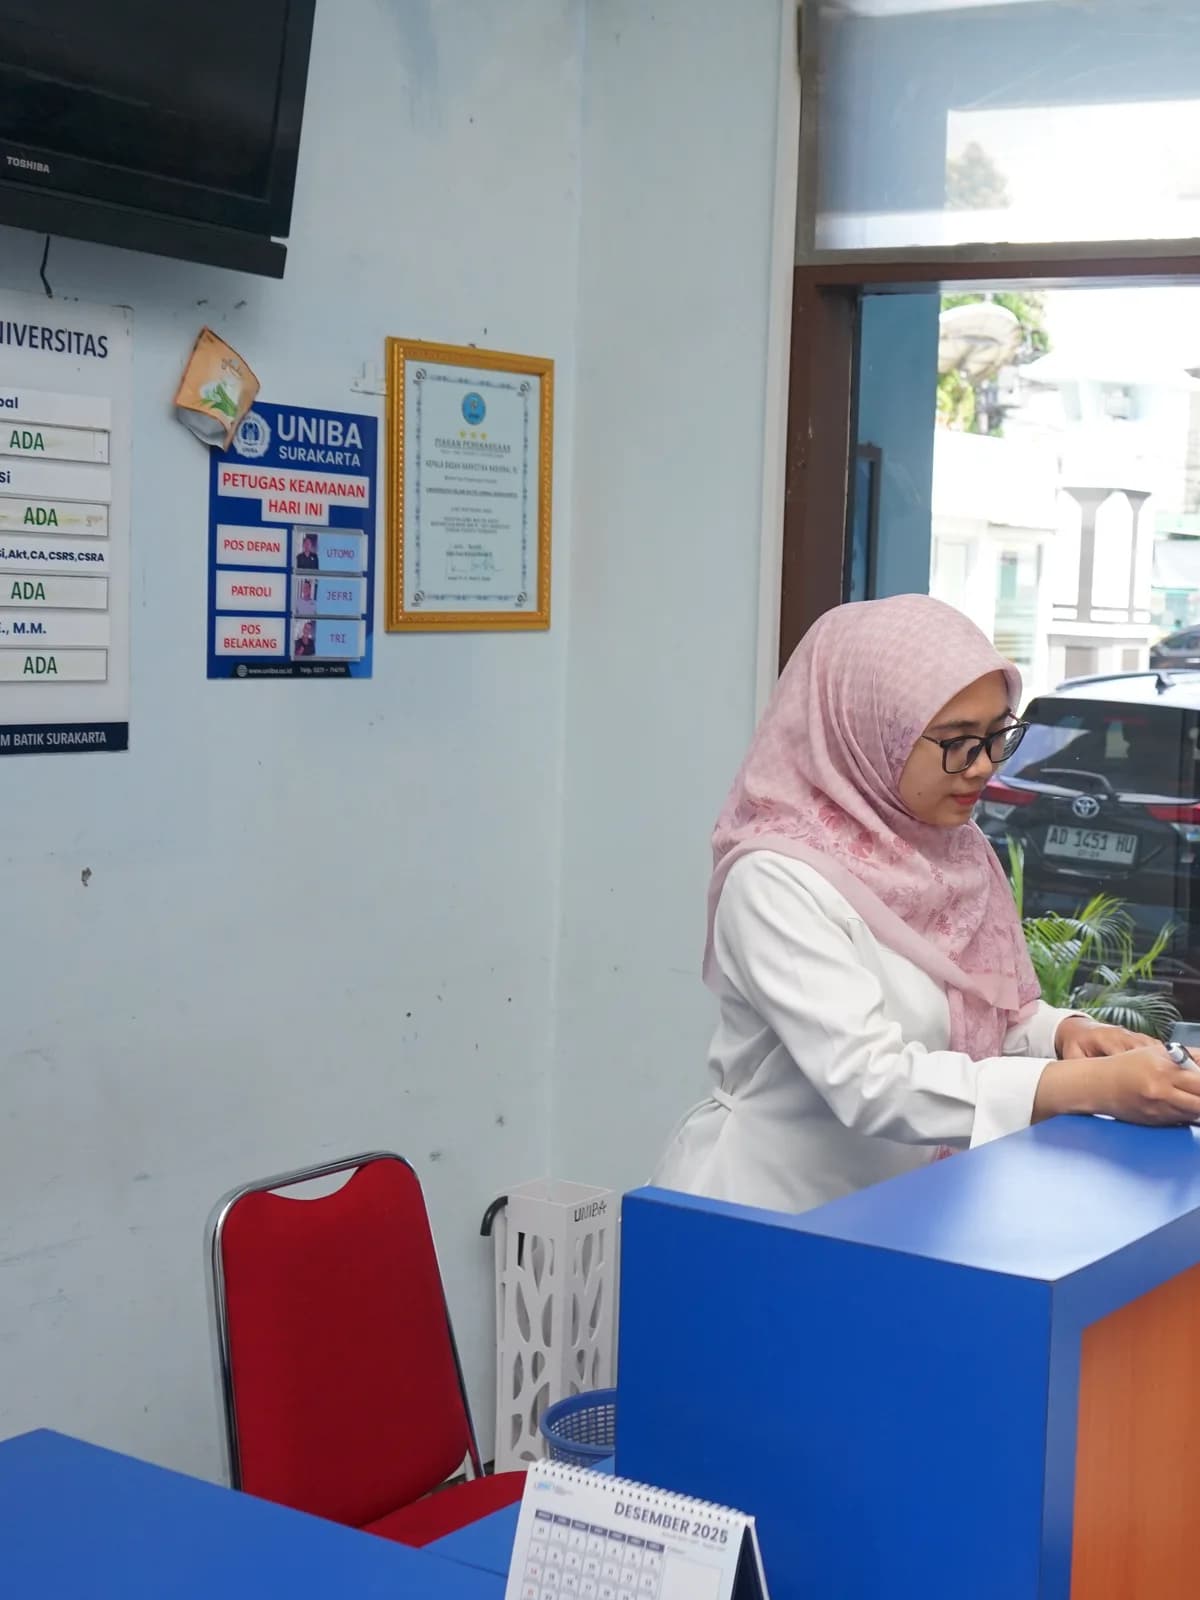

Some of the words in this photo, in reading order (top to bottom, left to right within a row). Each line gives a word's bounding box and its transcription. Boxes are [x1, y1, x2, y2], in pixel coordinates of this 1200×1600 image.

[6, 155, 50, 174] TOSHIBA
[9, 430, 45, 451] ADA
[277, 413, 363, 449] UNIBA
[279, 446, 361, 467] SURAKARTA
[222, 472, 286, 492] PETUGAS
[289, 479, 366, 498] KEAMANAN
[23, 507, 58, 527] ADA
[268, 500, 301, 514] HARI
[304, 503, 323, 516] INI
[223, 539, 244, 551] POS
[247, 541, 280, 553] DEPAN
[10, 581, 46, 600] ADA
[231, 585, 272, 597] PATROLI
[13, 622, 47, 634] M.M.
[240, 624, 261, 634] POS
[223, 637, 277, 649] BELAKANG
[329, 633, 346, 644] TRI
[23, 656, 58, 675] ADA
[14, 733, 45, 746] BATIK
[46, 731, 107, 745] SURAKARTA
[1048, 826, 1069, 845] AD
[1072, 830, 1108, 850] 1451
[614, 1501, 690, 1534] DESEMBER
[691, 1522, 729, 1544] 2025
